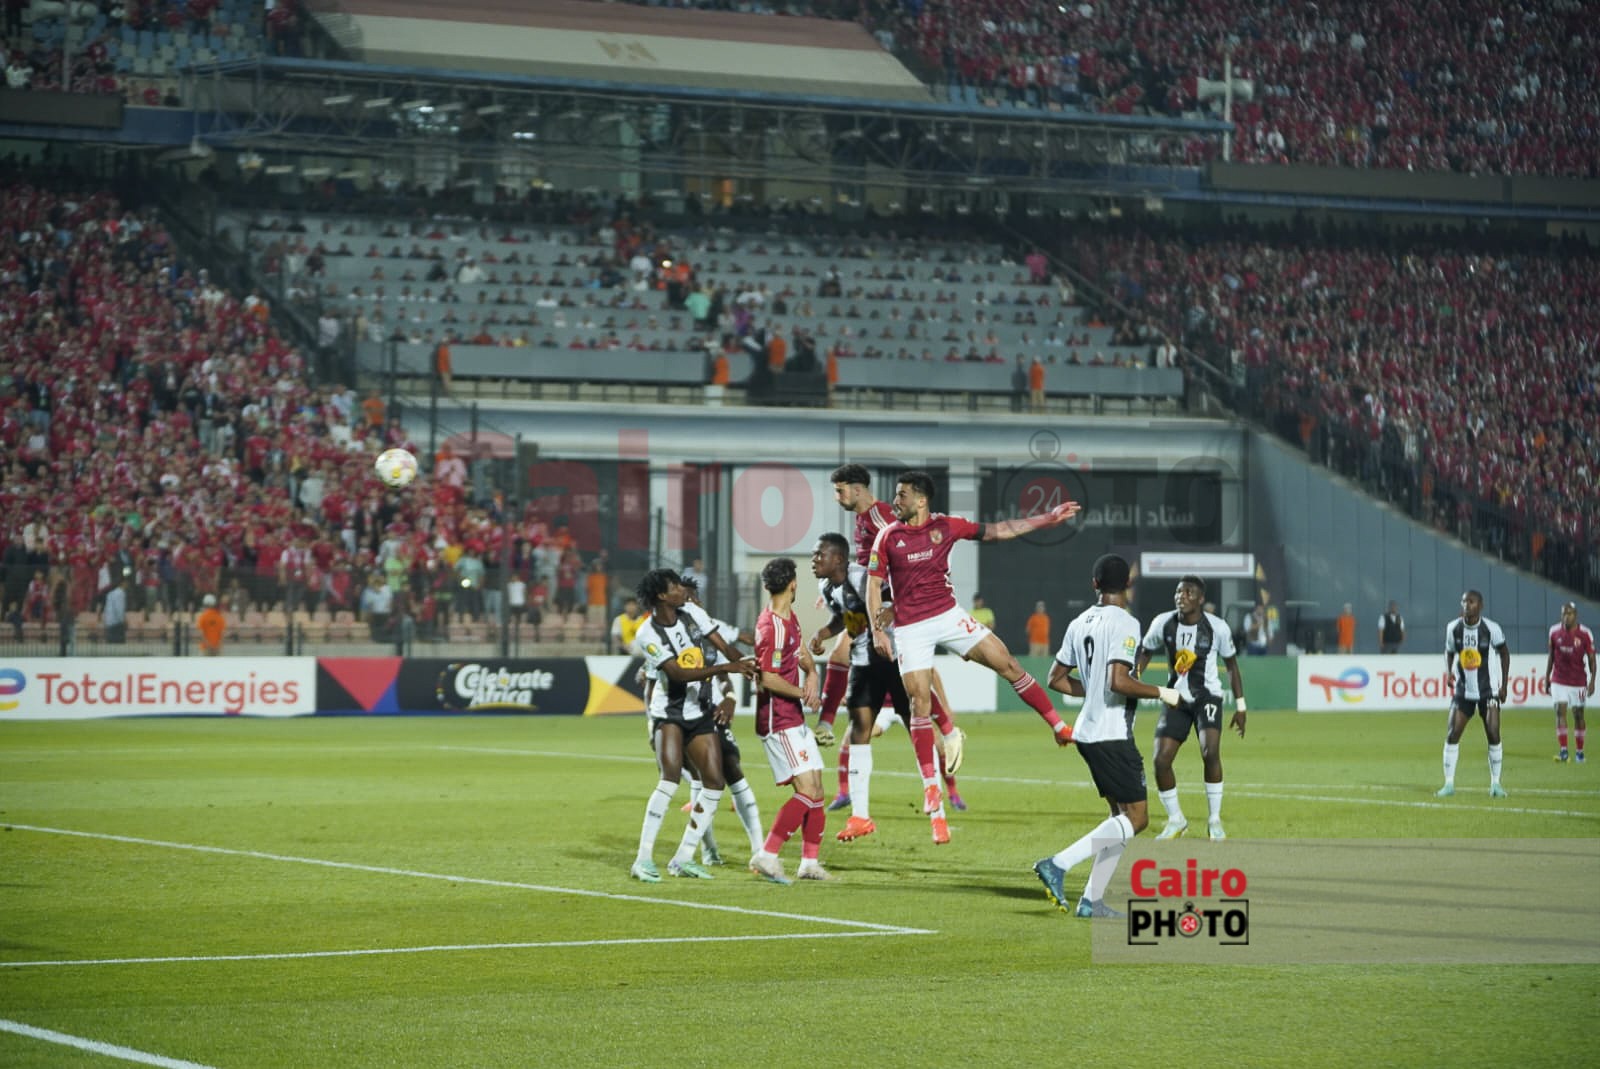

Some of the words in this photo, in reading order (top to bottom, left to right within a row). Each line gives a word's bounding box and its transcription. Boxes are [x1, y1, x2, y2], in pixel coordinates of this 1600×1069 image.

[675, 632, 687, 648] 2
[1181, 632, 1193, 645] 17
[1464, 635, 1477, 647] 35
[454, 663, 554, 698] Celebrate
[36, 672, 299, 713] TotalEnergies
[1204, 703, 1218, 721] 17
